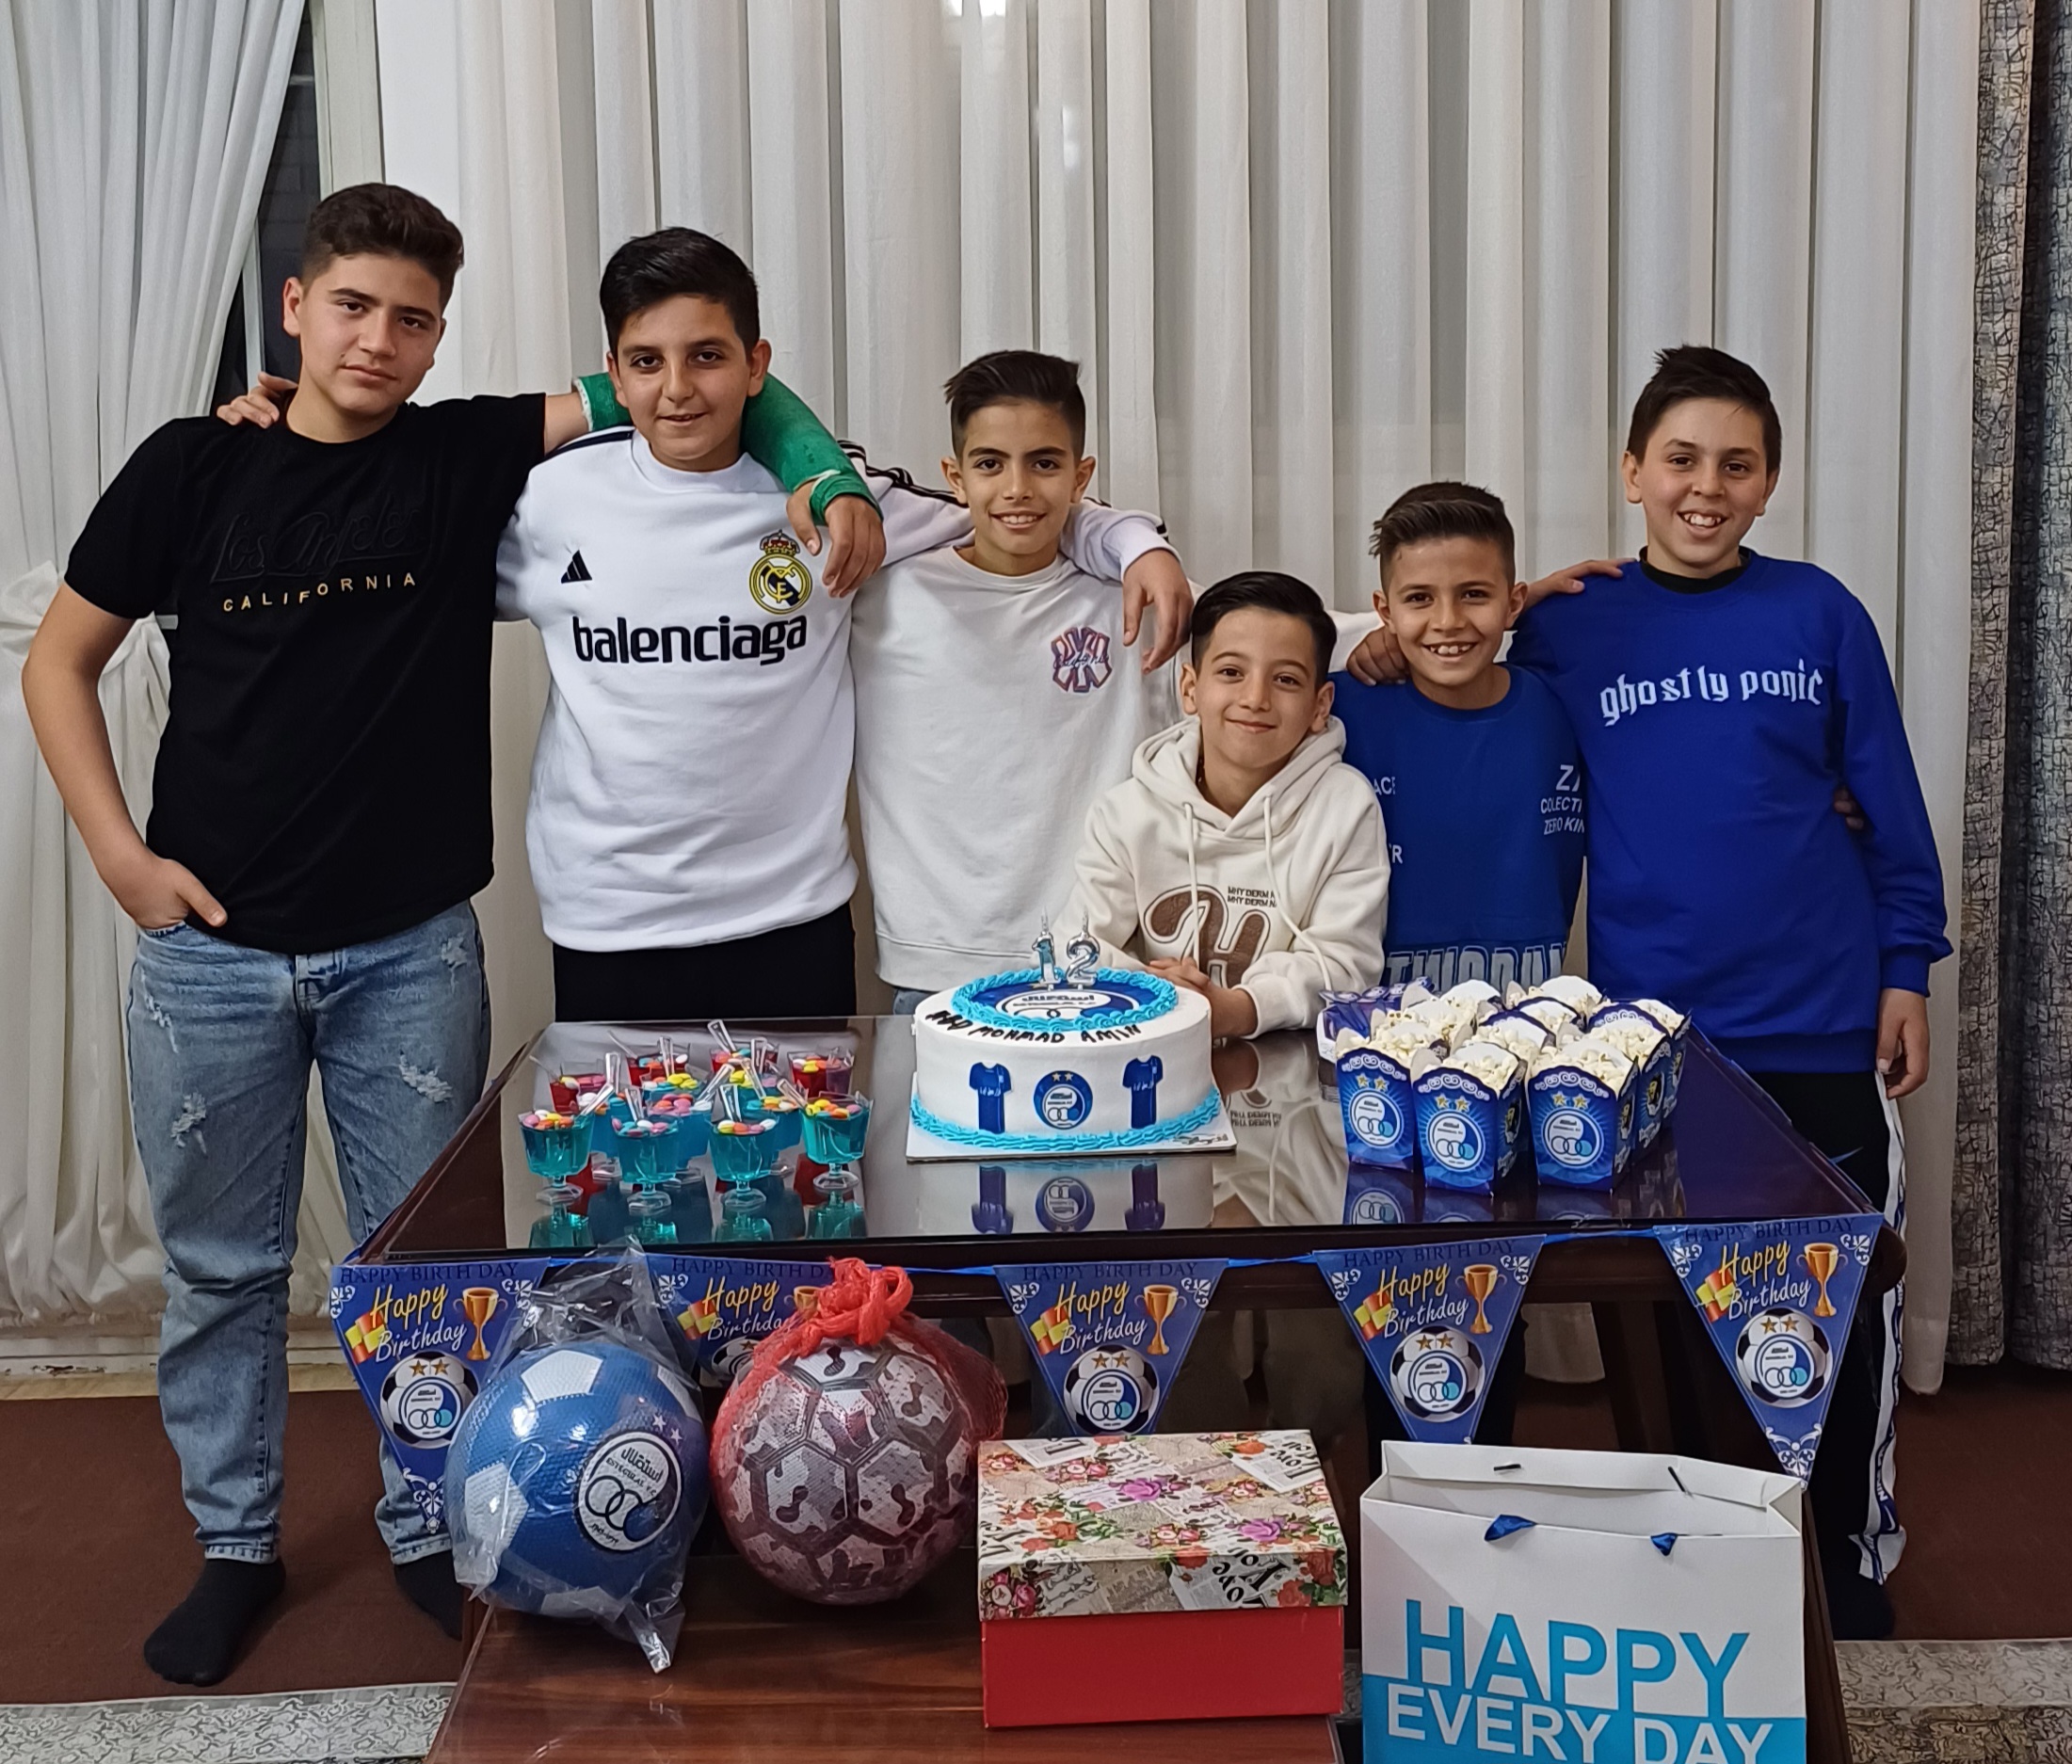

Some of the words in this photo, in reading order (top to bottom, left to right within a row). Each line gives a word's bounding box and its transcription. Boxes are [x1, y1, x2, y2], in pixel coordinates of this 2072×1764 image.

[223, 572, 416, 612] CALIFORNIA
[572, 615, 808, 666] balenciaga
[1080, 1023, 1142, 1044] AMIN
[1684, 1225, 1748, 1243] HAPPY
[1756, 1220, 1811, 1238] BIRTH
[1817, 1217, 1855, 1233] DAY
[340, 1267, 401, 1283] HAPPY
[411, 1265, 471, 1281] BIRTH
[478, 1262, 519, 1277] DAY
[671, 1258, 732, 1275] HAPPY
[745, 1262, 801, 1277] BIRTH
[1023, 1264, 1084, 1281] HAPPY
[1095, 1263, 1150, 1278] BIRTH
[1154, 1261, 1197, 1277] DAY
[1343, 1250, 1406, 1268] HAPPY
[1414, 1243, 1471, 1262] BIRTH
[1479, 1240, 1517, 1256] DAY
[1718, 1240, 1791, 1287] Happy
[370, 1283, 449, 1330] Happy
[702, 1275, 780, 1319] Happy
[1054, 1280, 1131, 1324] Happy
[1376, 1262, 1451, 1307] Happy
[1728, 1275, 1812, 1321] Birthday
[1060, 1312, 1148, 1355] Birthday
[1384, 1293, 1469, 1338] Birthday
[376, 1317, 467, 1363] Birthday
[1406, 1598, 1750, 1718] HAPPY
[1388, 1682, 1611, 1764] EVERY
[1633, 1717, 1774, 1764] DAY
